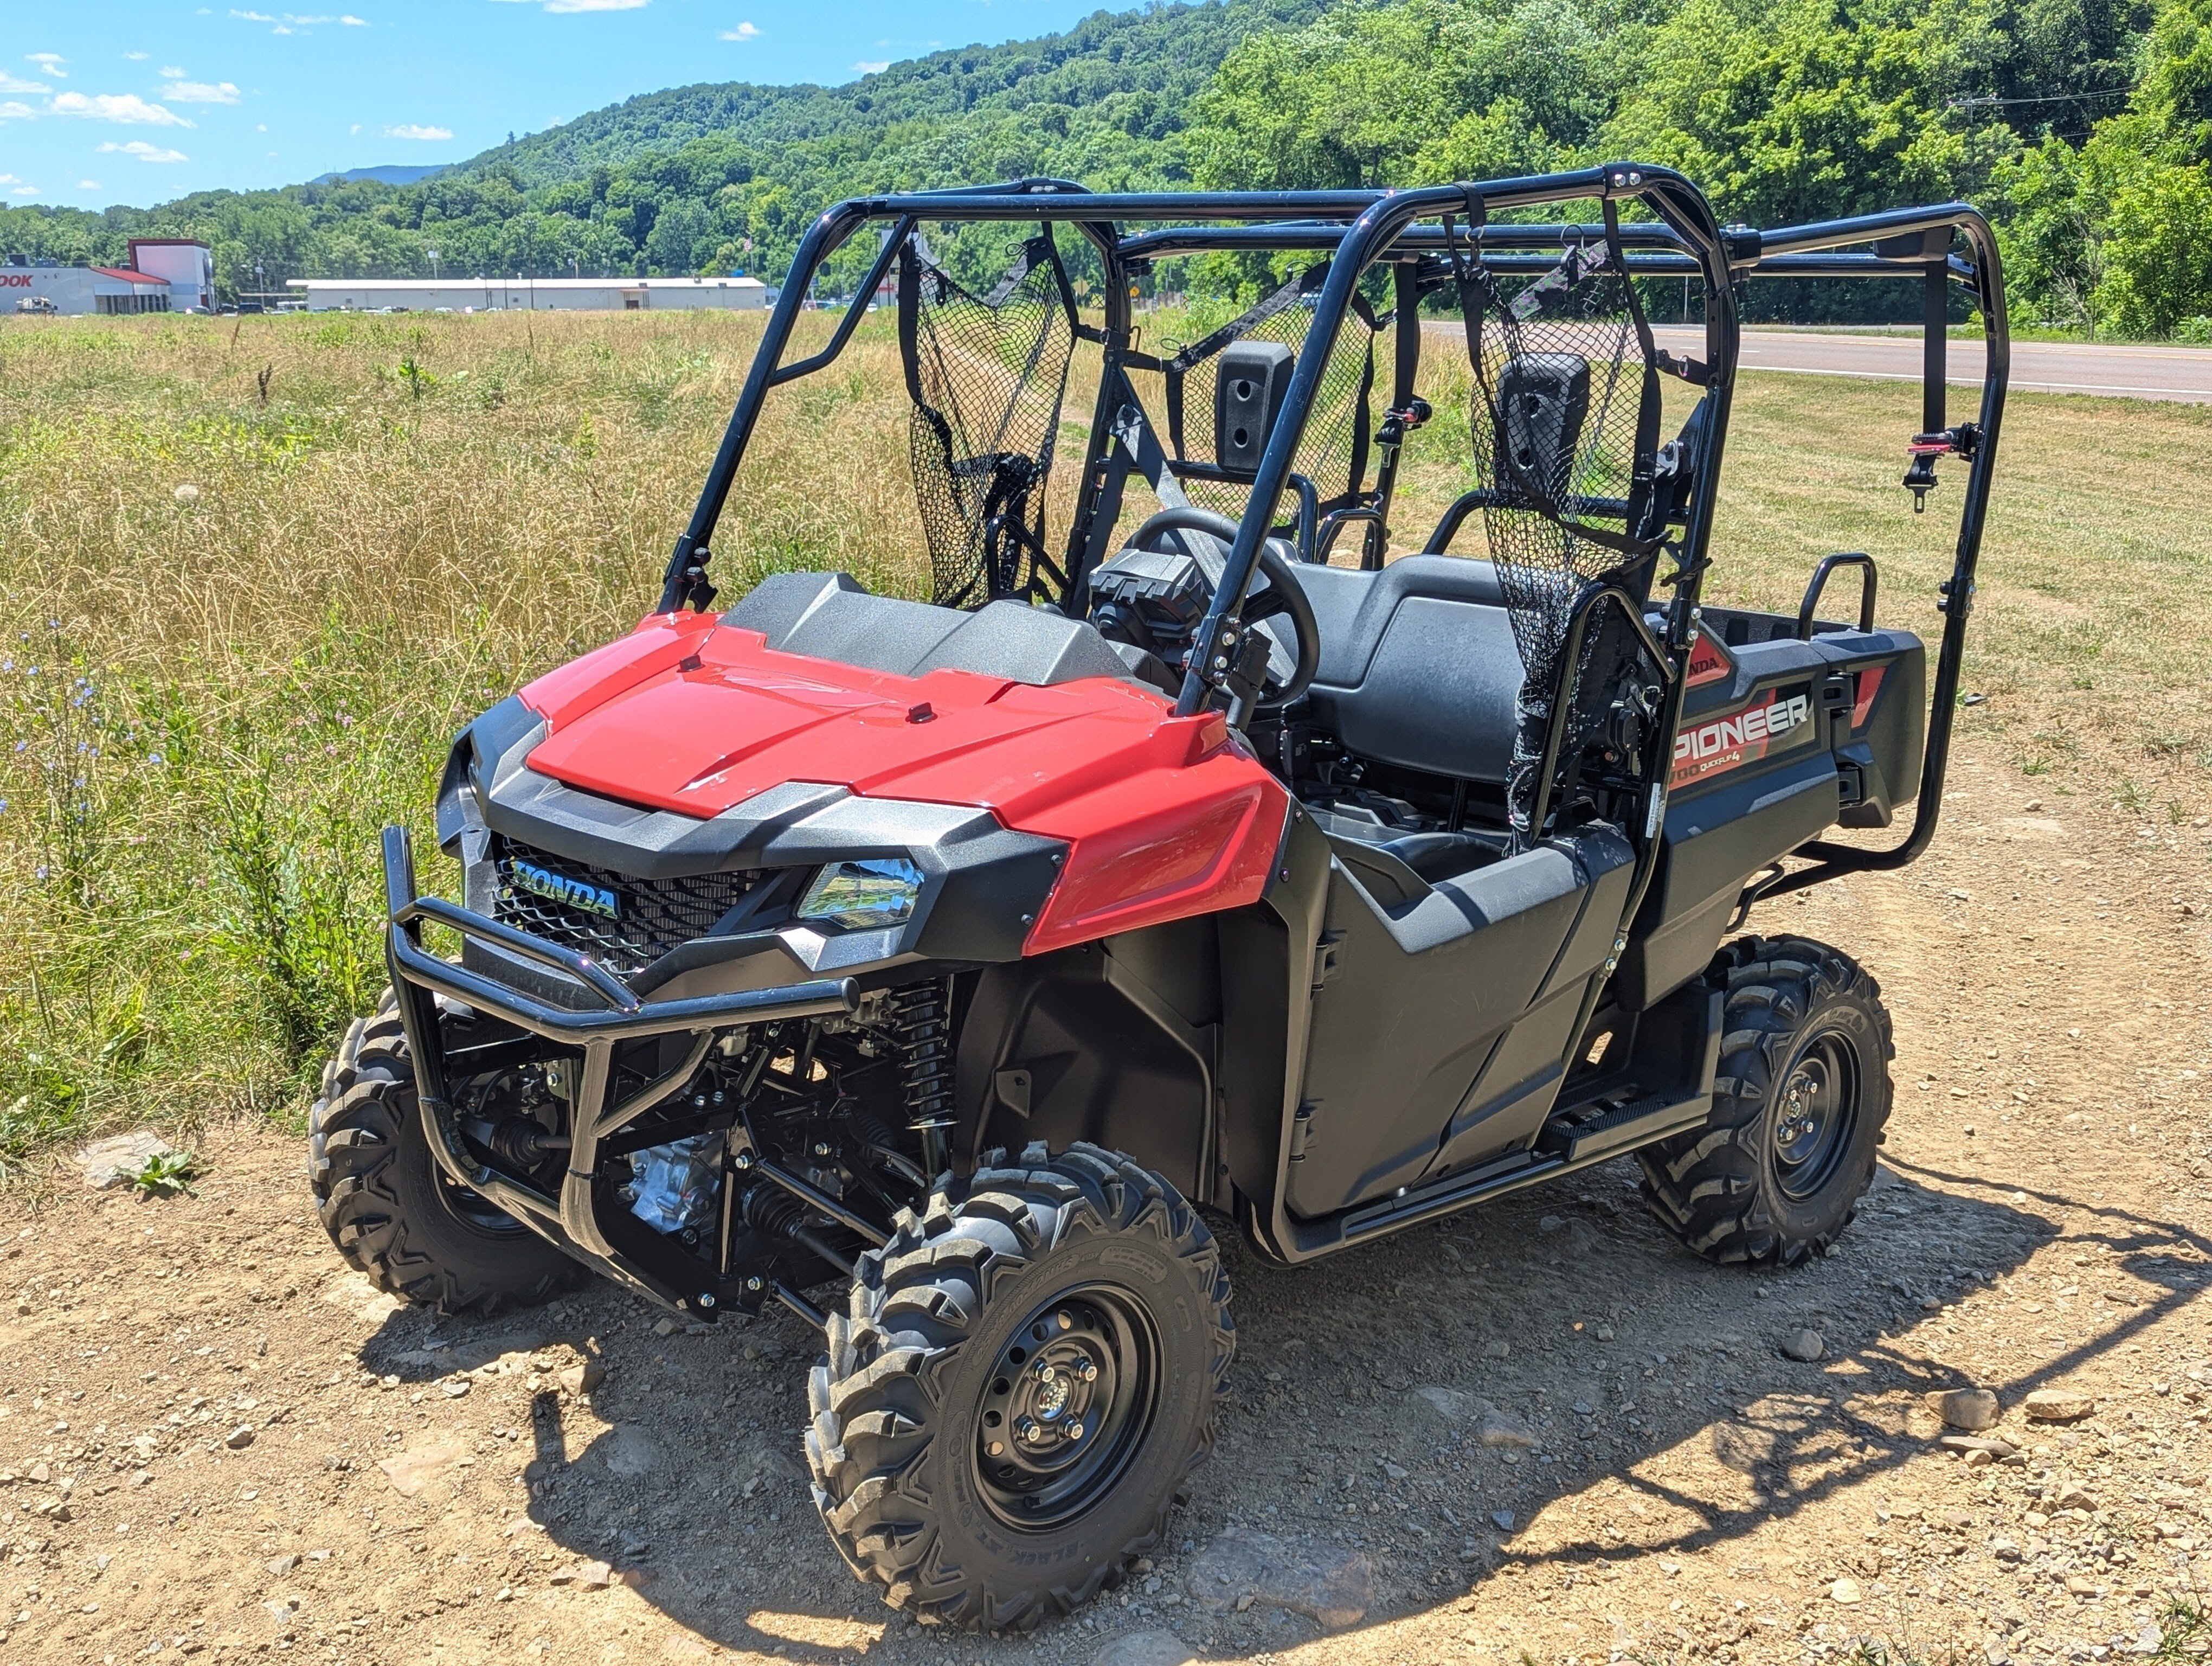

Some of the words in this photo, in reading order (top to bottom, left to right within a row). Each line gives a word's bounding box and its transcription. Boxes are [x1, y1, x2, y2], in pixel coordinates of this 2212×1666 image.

[0, 275, 33, 287] OOK
[1688, 657, 1719, 676] NDA
[1672, 694, 1808, 767] PIONEER
[510, 861, 618, 920] HONDA
